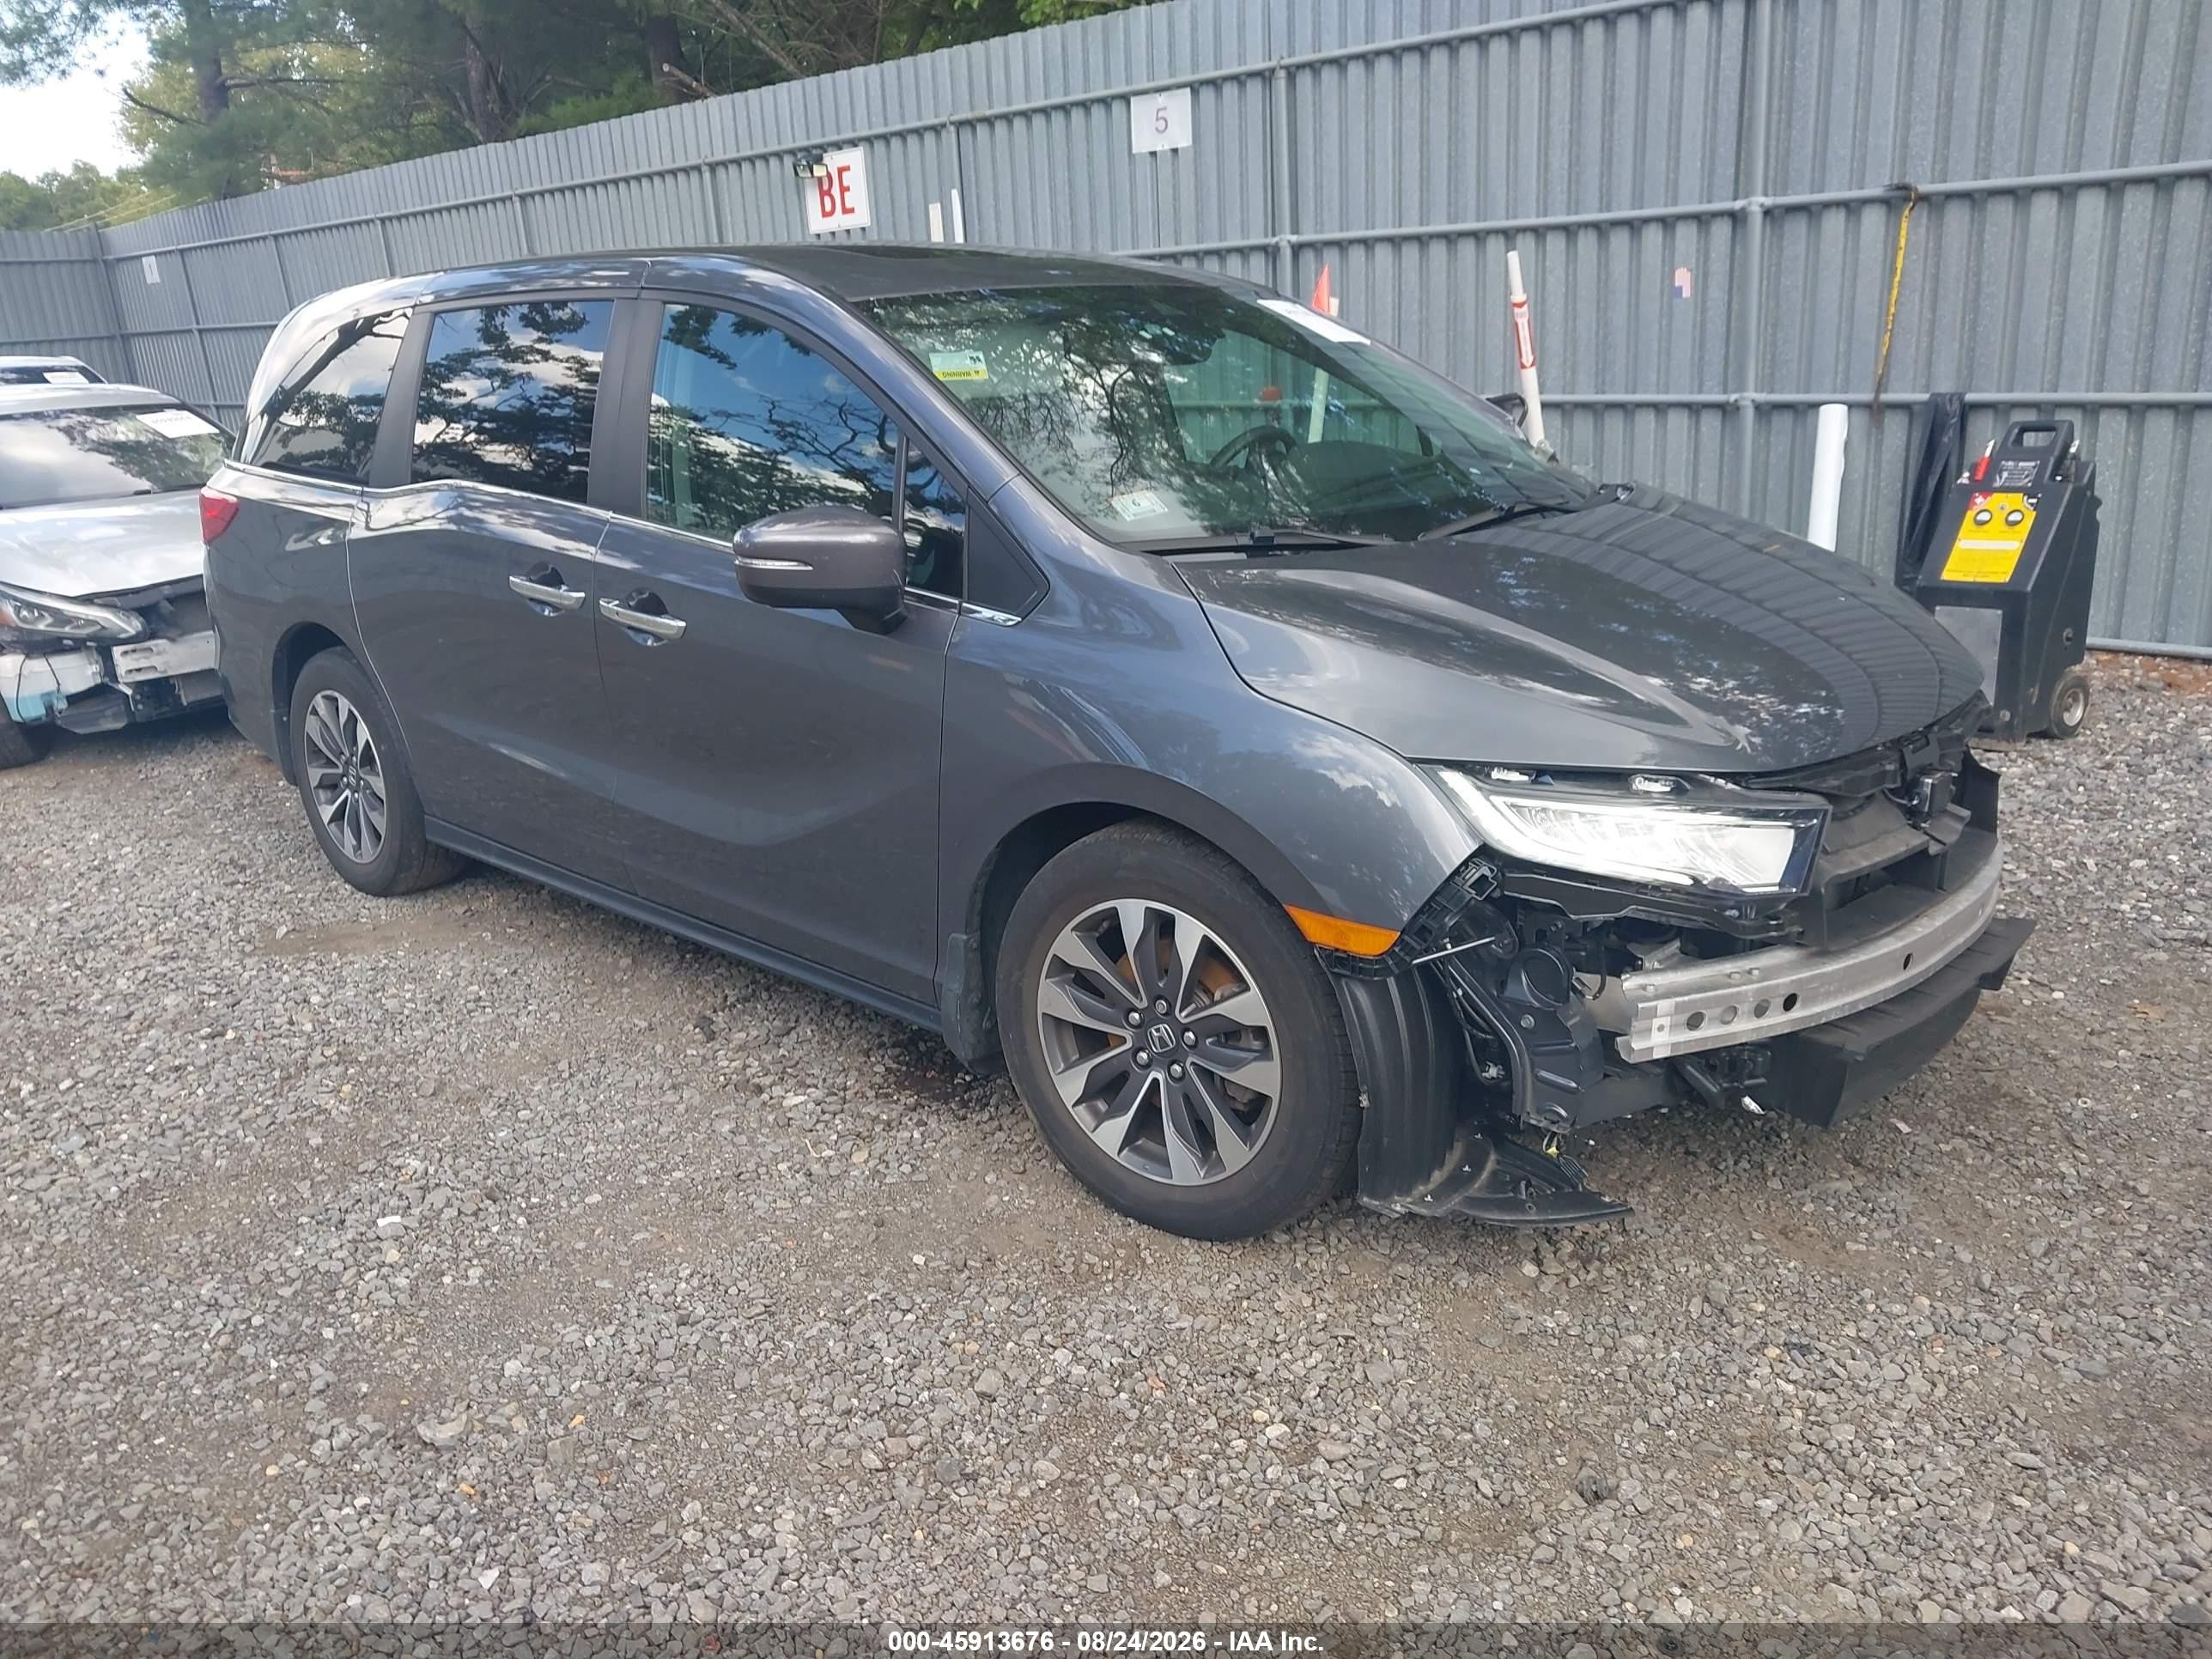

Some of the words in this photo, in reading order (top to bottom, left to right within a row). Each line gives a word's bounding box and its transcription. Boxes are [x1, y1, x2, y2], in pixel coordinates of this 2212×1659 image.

[1155, 106, 1169, 134] 5
[817, 165, 855, 219] BE
[942, 370, 972, 379] WARNING
